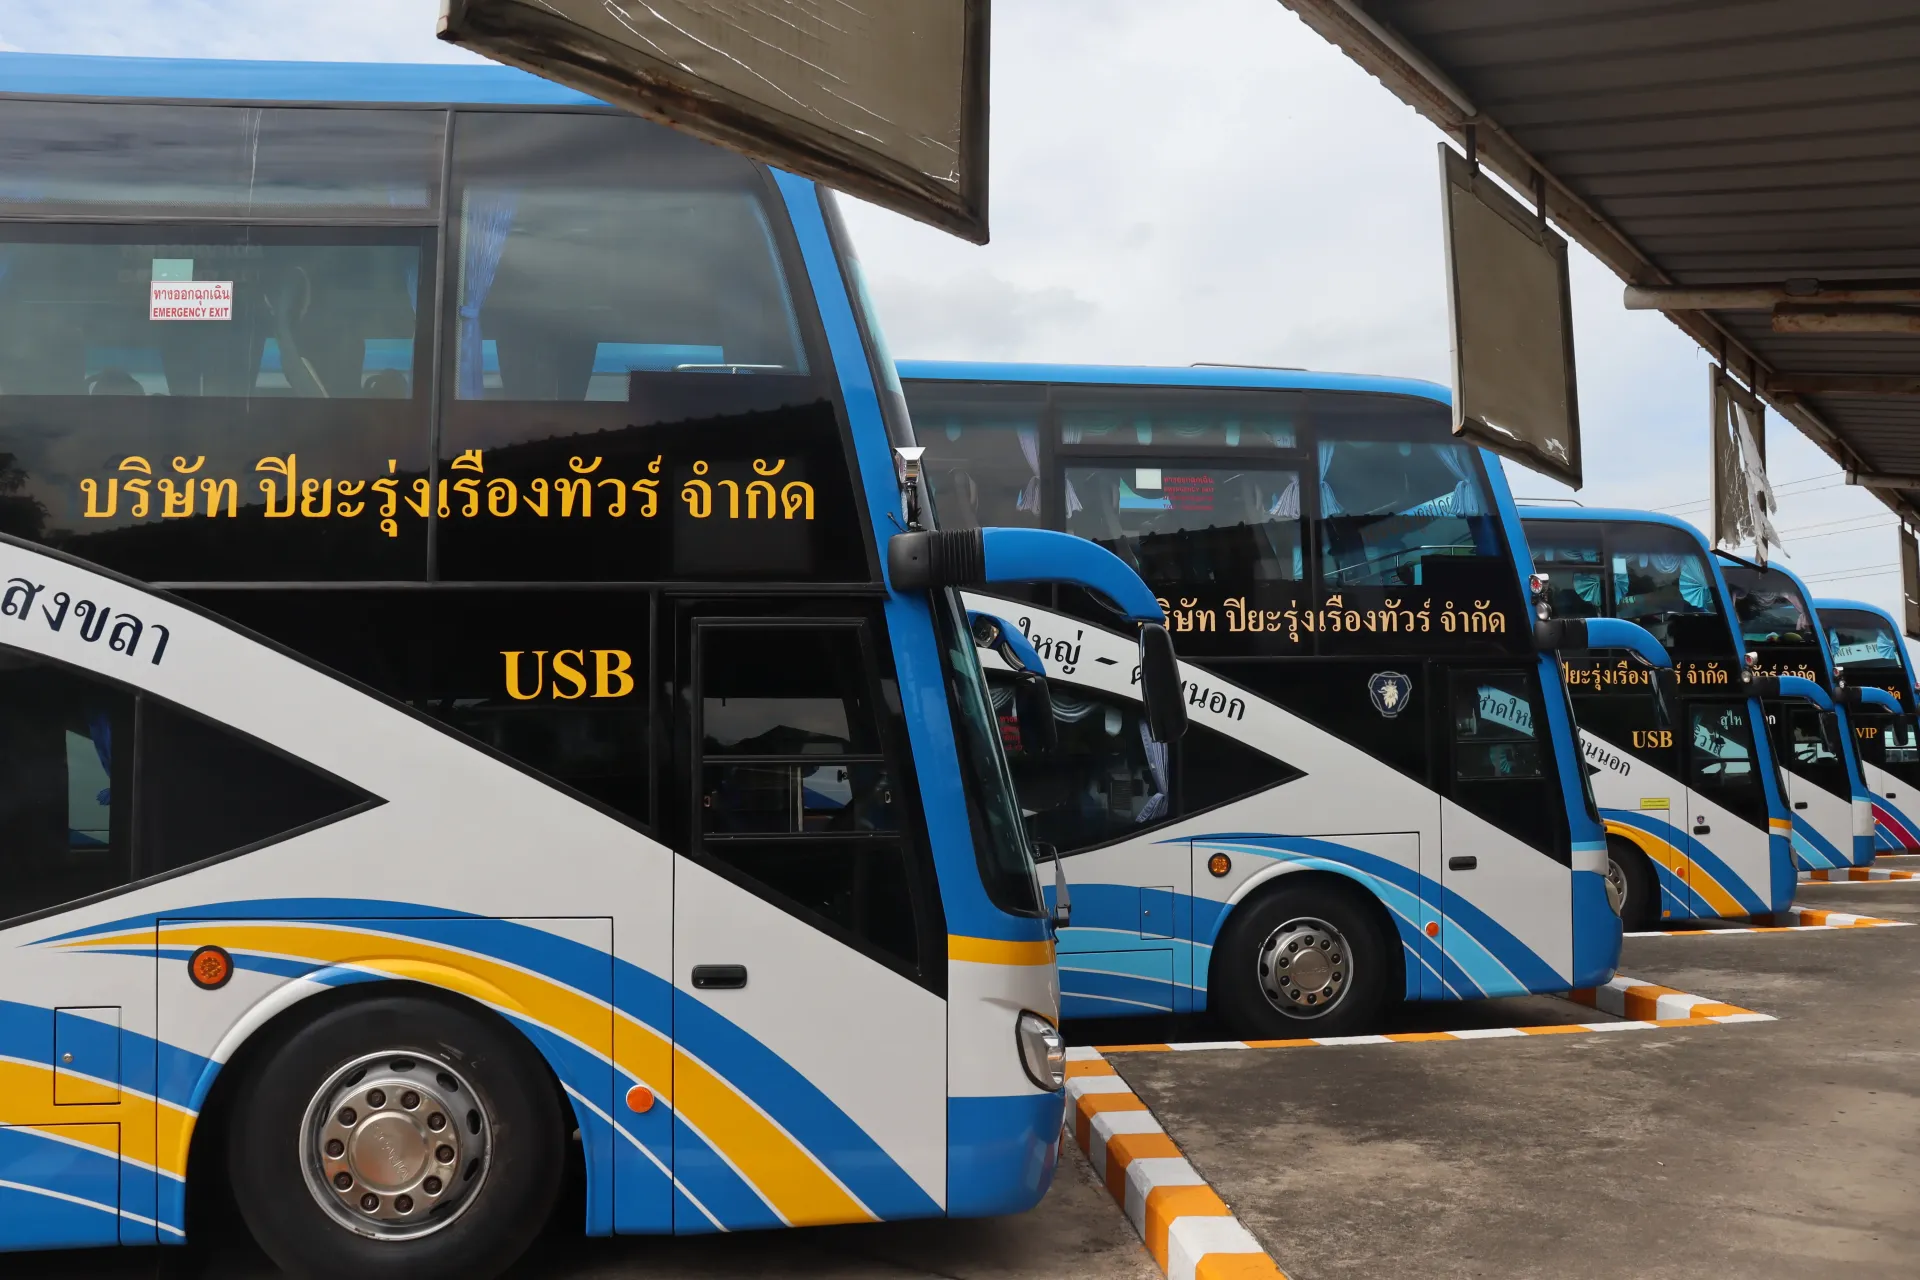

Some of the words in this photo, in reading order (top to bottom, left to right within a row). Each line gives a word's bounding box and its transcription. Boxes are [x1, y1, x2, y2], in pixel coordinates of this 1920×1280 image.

[153, 284, 230, 306] ทางออกฉุกเฉิน
[153, 307, 207, 318] EMERGENCY
[209, 307, 229, 318] EXIT
[80, 455, 239, 518] บริษัท
[255, 449, 663, 538] ปิยะรุ่งเรืองทัวร์
[681, 458, 815, 520] จำกัด
[1, 577, 170, 666] สงขลา
[1156, 597, 1216, 632] ิษัท
[1223, 594, 1431, 643] ปิยะรุ่งเรืองทัวร์
[1440, 599, 1506, 633] จำกัด
[500, 648, 635, 700] USB
[1687, 663, 1728, 684] จำกัด
[1632, 730, 1673, 748] USB
[1855, 727, 1877, 738] VIP
[1580, 738, 1631, 776] านนอก
